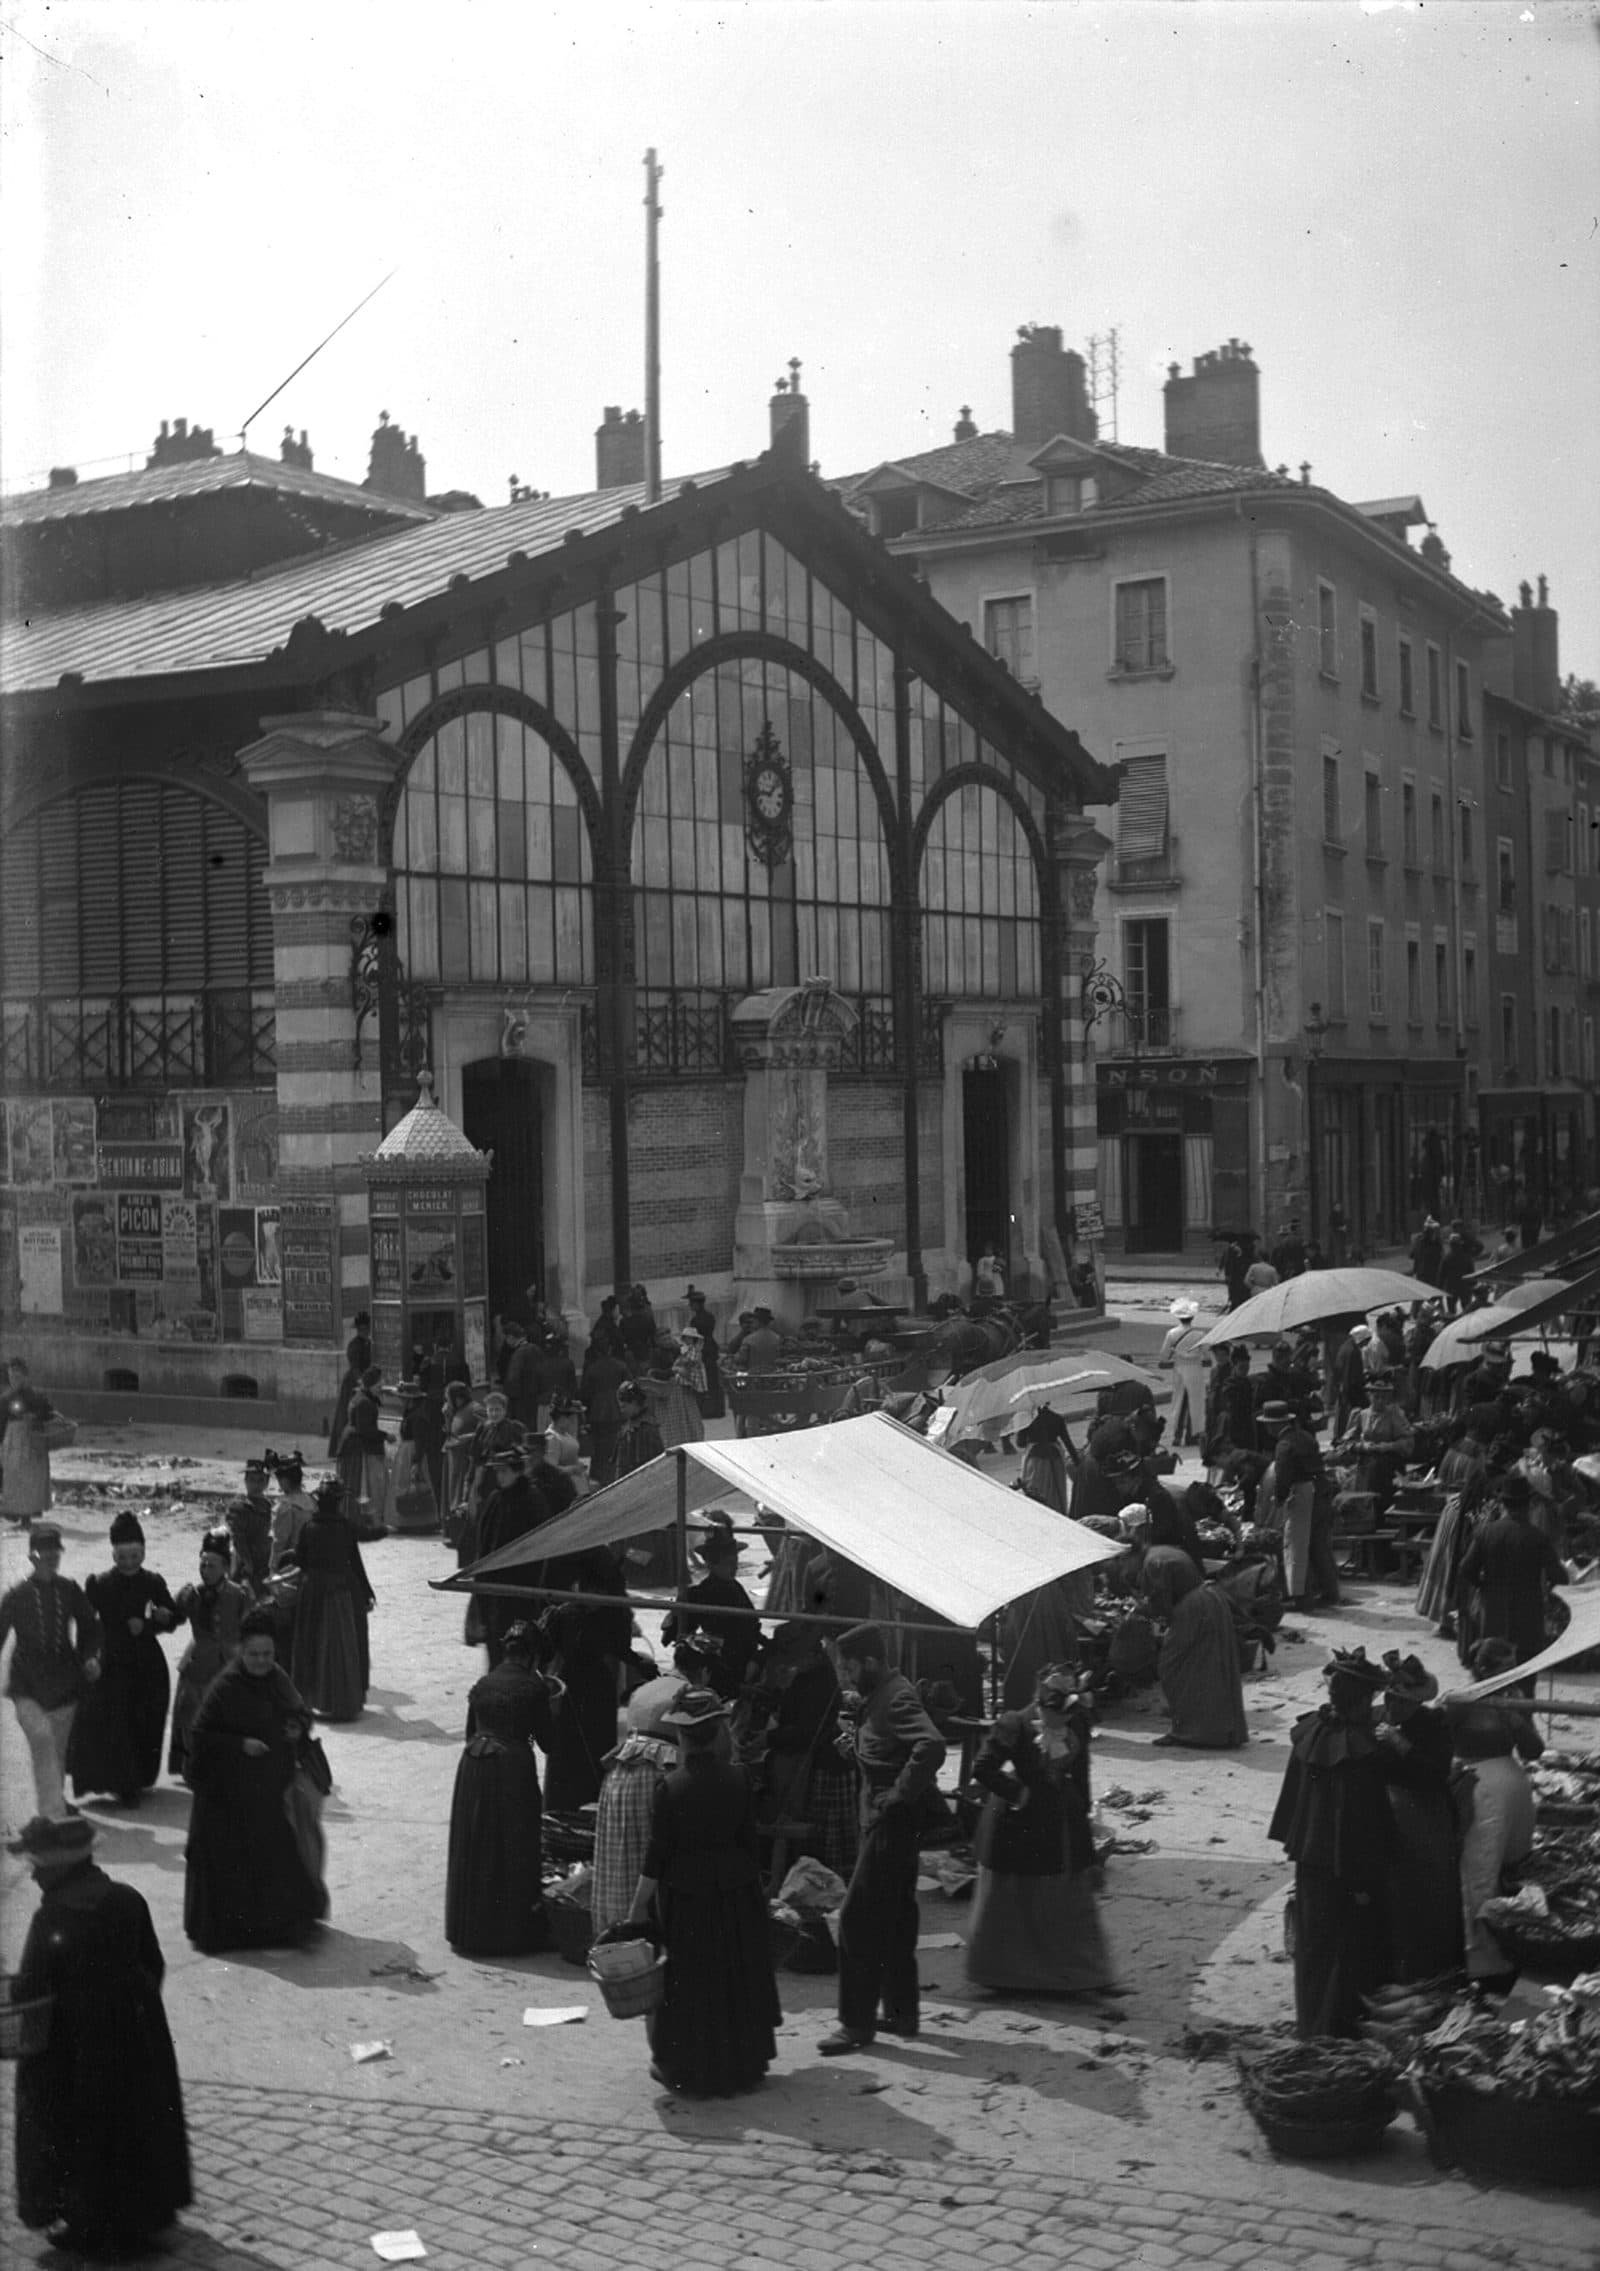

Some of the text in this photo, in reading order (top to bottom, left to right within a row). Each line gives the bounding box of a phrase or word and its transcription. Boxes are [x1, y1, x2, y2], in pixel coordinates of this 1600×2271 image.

[1108, 1067, 1219, 1085] NSON
[407, 1191, 453, 1201] CHOCOLAT
[412, 1201, 449, 1211] MENIER
[120, 1207, 159, 1232] PICON
